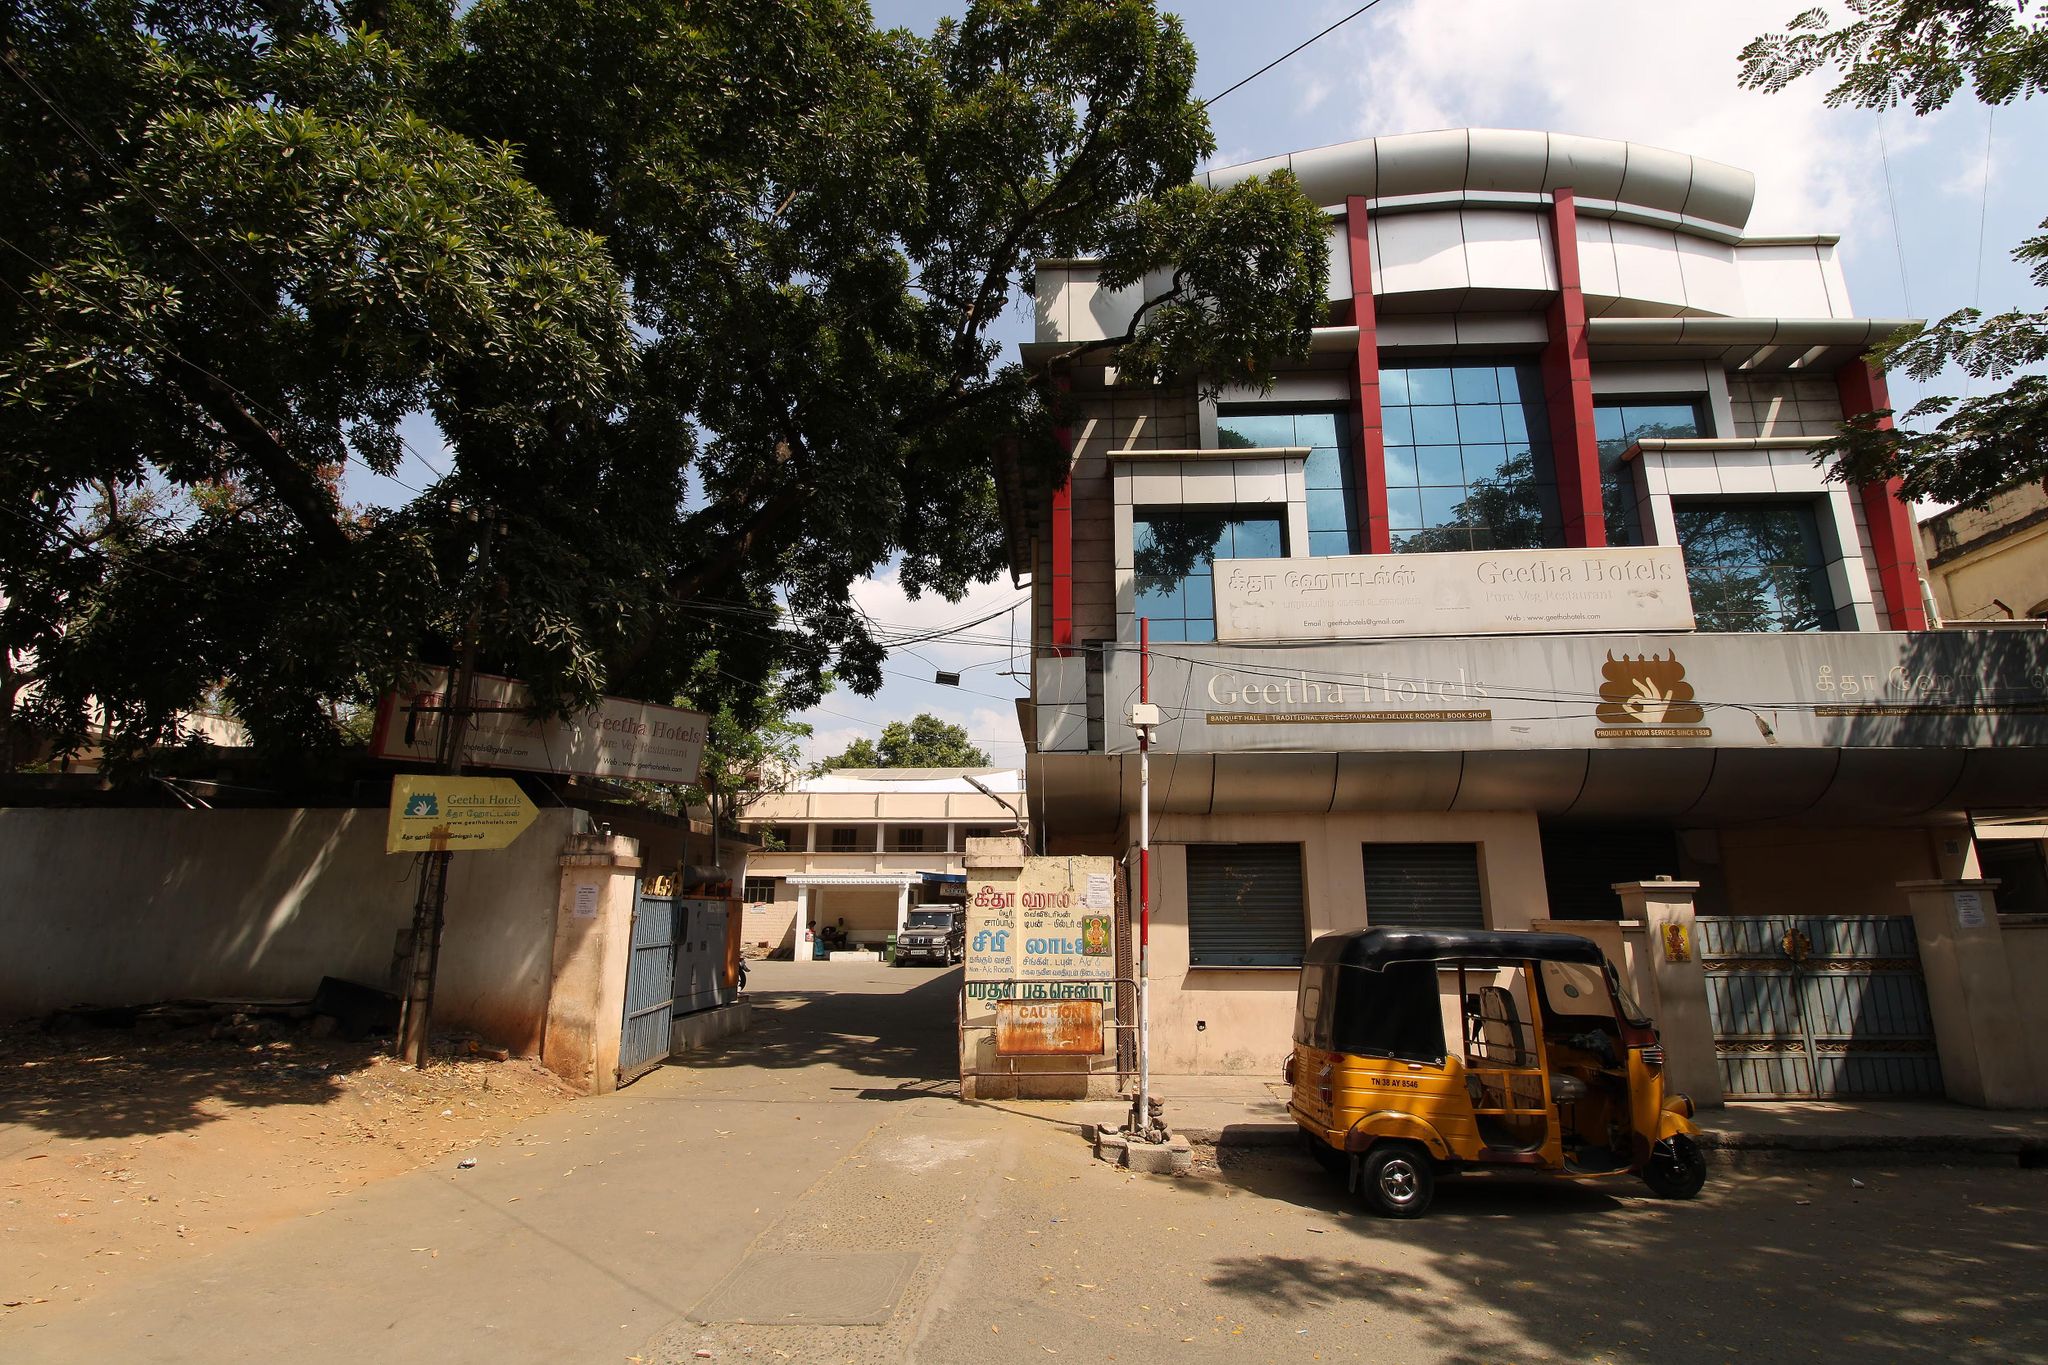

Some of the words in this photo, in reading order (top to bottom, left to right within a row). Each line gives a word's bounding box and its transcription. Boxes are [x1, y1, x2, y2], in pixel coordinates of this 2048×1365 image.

[1476, 560, 1573, 584] Geetha
[1582, 558, 1671, 581] Hotels
[1327, 618, 1405, 628] geethahotels@gmail.com
[1526, 613, 1601, 622] www.geethahotels.com
[1207, 671, 1344, 705] Geetha
[1362, 667, 1489, 704] Hotels
[588, 711, 648, 736] Geetha
[652, 720, 701, 744] Hotels
[447, 794, 485, 805] Geetha
[489, 794, 521, 805] Hotels
[974, 885, 1016, 910] கீதா
[1019, 1006, 1081, 1019] CAUTION
[1382, 1078, 1390, 1086] 38
[1392, 1079, 1401, 1087] AY
[1402, 1080, 1418, 1088] 8546
